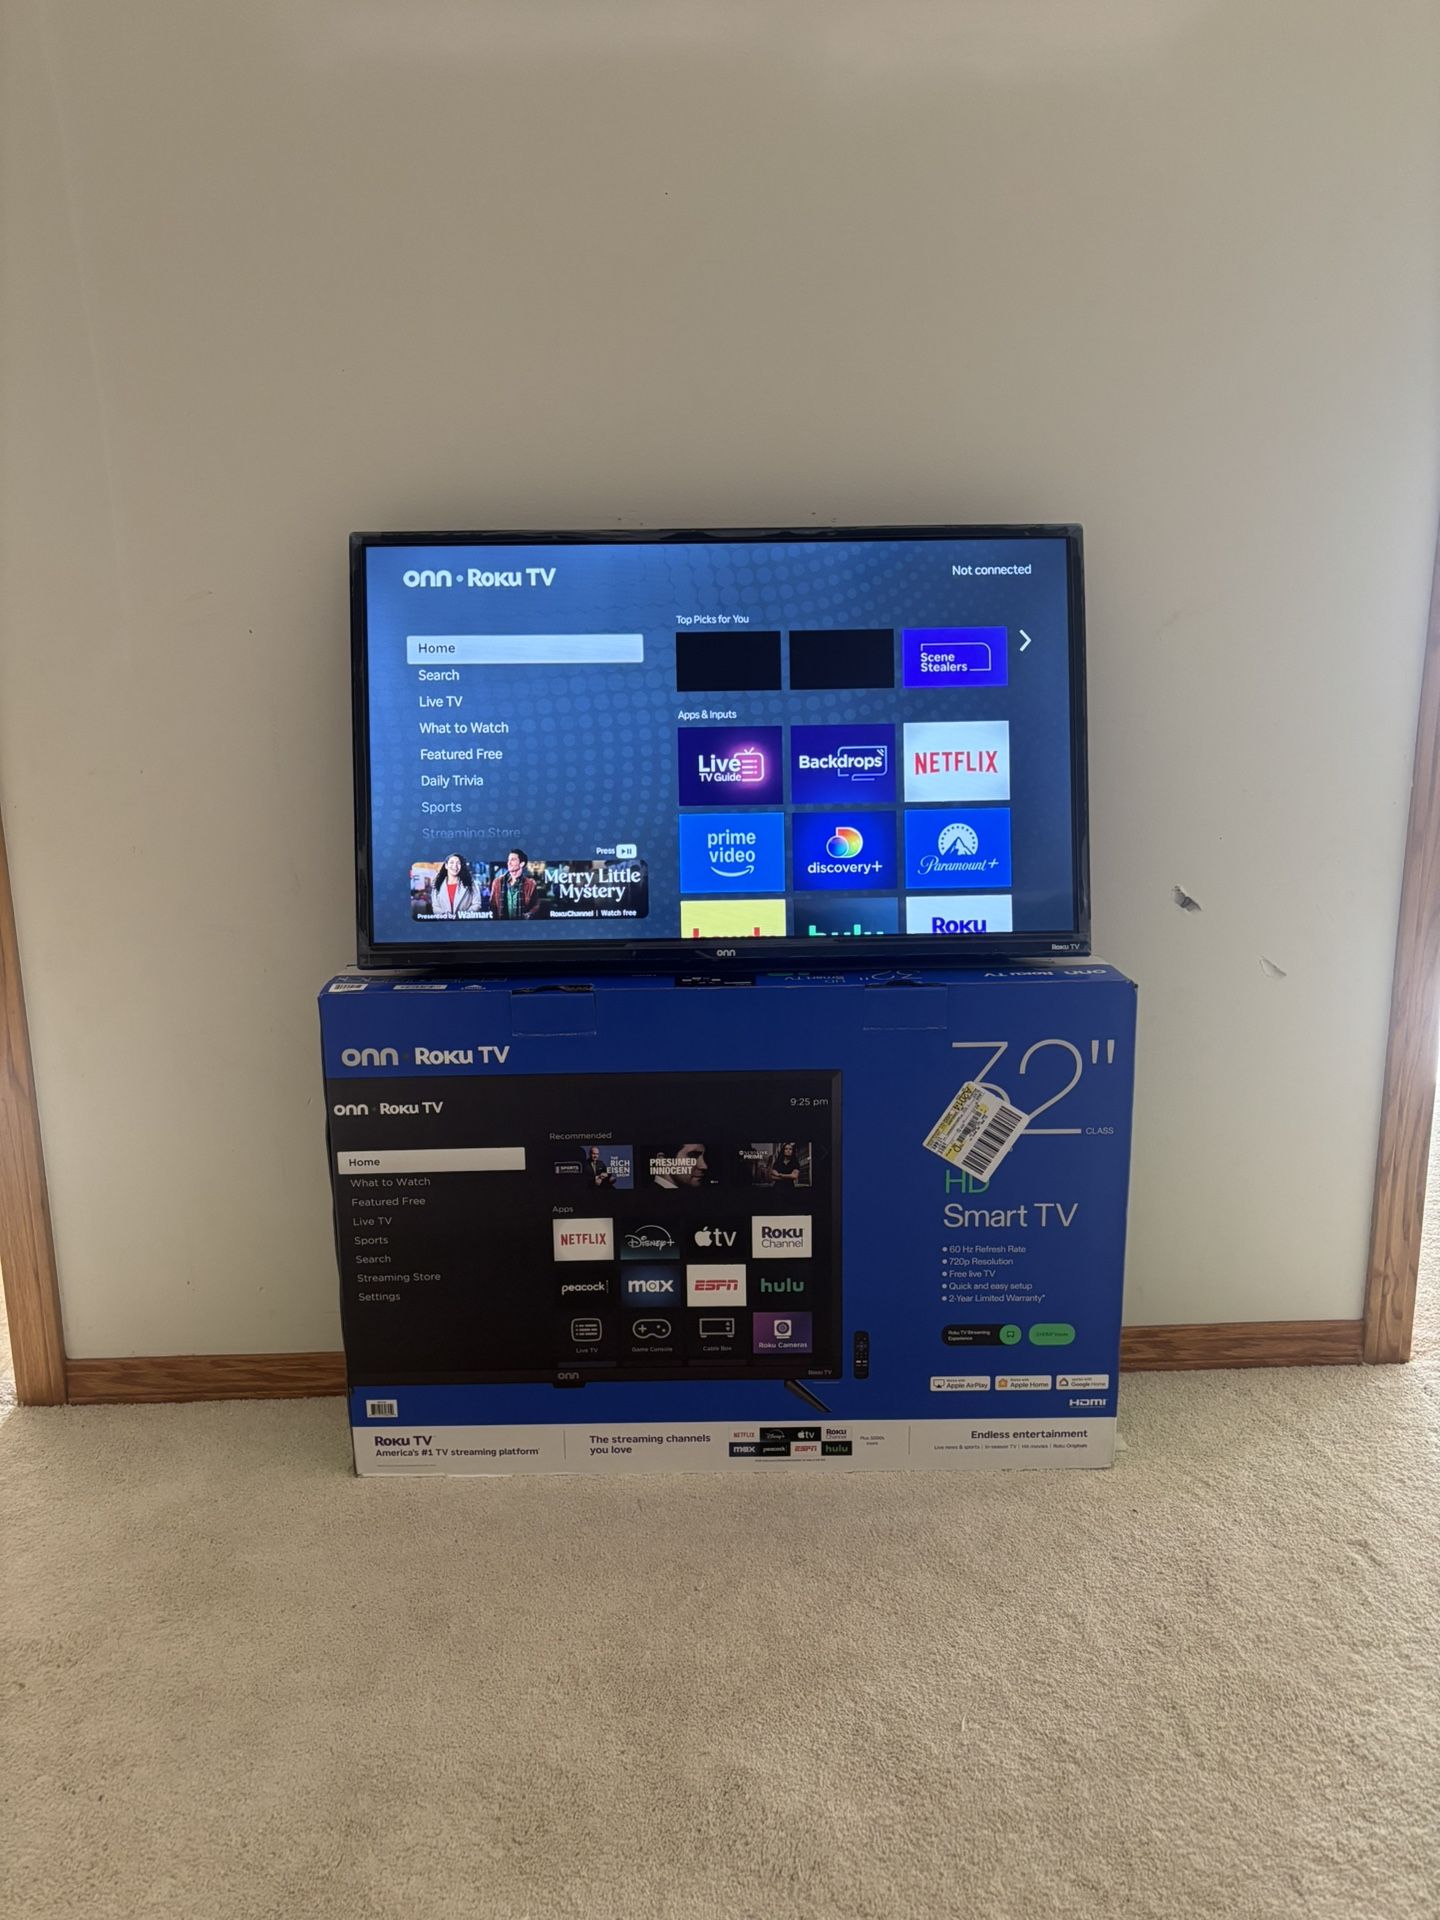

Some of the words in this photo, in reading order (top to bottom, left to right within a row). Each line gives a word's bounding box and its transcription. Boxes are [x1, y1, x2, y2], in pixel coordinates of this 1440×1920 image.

[952, 565, 973, 575] Not
[975, 564, 1032, 575] connected
[403, 570, 452, 587] onn
[468, 568, 522, 587] Roku
[526, 567, 556, 586] TV
[676, 615, 695, 626] Top
[697, 615, 716, 624] Picks
[717, 614, 731, 624] for
[732, 614, 749, 624] You
[418, 642, 456, 654] Home
[920, 652, 955, 663] Scene
[920, 661, 968, 673] Stealers
[418, 669, 460, 682] Search
[419, 696, 443, 708] Live
[446, 696, 463, 708] TV
[678, 710, 700, 721] Apps
[701, 709, 708, 719] &
[710, 709, 737, 720] Inputs
[419, 722, 451, 735] What
[454, 722, 468, 734] to
[470, 722, 509, 734] Watch
[421, 749, 473, 761] Featured
[476, 749, 503, 760] Free
[698, 754, 741, 774] Live
[799, 755, 882, 771] Backdrops
[914, 750, 998, 776] NETFLIX
[421, 775, 451, 788] Daily
[453, 775, 484, 787] Trivia
[699, 773, 713, 783] TV
[714, 773, 742, 783] Guide
[421, 802, 462, 814] Sports
[422, 828, 486, 841] Streaming
[488, 827, 521, 838] Store
[707, 829, 756, 850] prime
[596, 847, 616, 856] Press
[709, 848, 756, 863] video
[807, 860, 883, 876] discovery+
[917, 854, 1000, 876] Paramount+
[544, 869, 595, 886] Merry
[598, 868, 641, 884] Little
[559, 883, 626, 903] Mystery
[417, 912, 448, 920] Presented
[448, 912, 456, 920] by
[458, 910, 493, 920] Walmart
[600, 909, 621, 917] Watch
[623, 909, 637, 917] free
[932, 917, 987, 934] Roku
[716, 949, 736, 957] onn
[341, 1048, 399, 1067] onn
[415, 1047, 473, 1065] Roku
[478, 1046, 510, 1064] TV
[333, 1103, 369, 1116] onn
[380, 1102, 419, 1115] Roku
[422, 1101, 444, 1114] TV
[812, 1098, 829, 1107] pm
[549, 1132, 612, 1141] Recommended
[1085, 1127, 1114, 1135] CLASS
[348, 1158, 380, 1167] Home
[650, 1158, 697, 1167] PRESUMED
[650, 1166, 693, 1175] INNOCENT
[350, 1178, 378, 1188] What
[382, 1178, 393, 1187] to
[396, 1177, 431, 1187] Watch
[945, 1169, 990, 1194] HD
[352, 1198, 399, 1207] Featured
[402, 1197, 426, 1206] Free
[552, 1206, 574, 1214] Apps
[943, 1203, 1028, 1227] Smart
[1034, 1203, 1079, 1227] TV
[353, 1217, 375, 1226] Live
[378, 1217, 392, 1226] TV
[713, 1228, 737, 1247] tv
[761, 1226, 803, 1239] Roku
[354, 1236, 389, 1247] Sports
[560, 1233, 606, 1246] NETFLIX
[624, 1234, 675, 1250] Disney+
[761, 1237, 803, 1249] Channel
[949, 1245, 961, 1253] 60
[962, 1245, 973, 1253] Hz
[975, 1245, 1006, 1253] Refresh
[1008, 1245, 1026, 1253] Rate
[355, 1255, 391, 1264] Search
[949, 1258, 970, 1266] 720p
[357, 1273, 410, 1283] Streaming
[413, 1272, 441, 1281] Store
[949, 1270, 967, 1278] Free
[969, 1270, 982, 1278] live
[984, 1270, 996, 1278] TV
[561, 1281, 605, 1295] peacock
[628, 1280, 674, 1293] max
[694, 1280, 739, 1291] ESPN
[760, 1278, 805, 1293] hulu
[990, 1283, 1009, 1291] easy
[1010, 1283, 1033, 1291] setup
[358, 1292, 401, 1302] Settings
[949, 1294, 973, 1302] 2-Year
[975, 1294, 1005, 1302] Limited
[557, 1372, 580, 1380] onn
[1069, 1398, 1107, 1407] HDMI
[589, 1435, 609, 1444] The
[611, 1434, 664, 1446] streaming
[666, 1434, 711, 1444] channels
[805, 1431, 815, 1439] tv
[971, 1430, 1010, 1439] Endless
[1012, 1429, 1088, 1439] entertainment
[375, 1436, 410, 1447] Roku
[413, 1435, 432, 1446] TV
[375, 1449, 419, 1457] America's
[435, 1448, 448, 1456] TV
[450, 1448, 497, 1458] streaming
[589, 1447, 609, 1456] you
[611, 1445, 632, 1454] love
[825, 1445, 848, 1453] hulu
